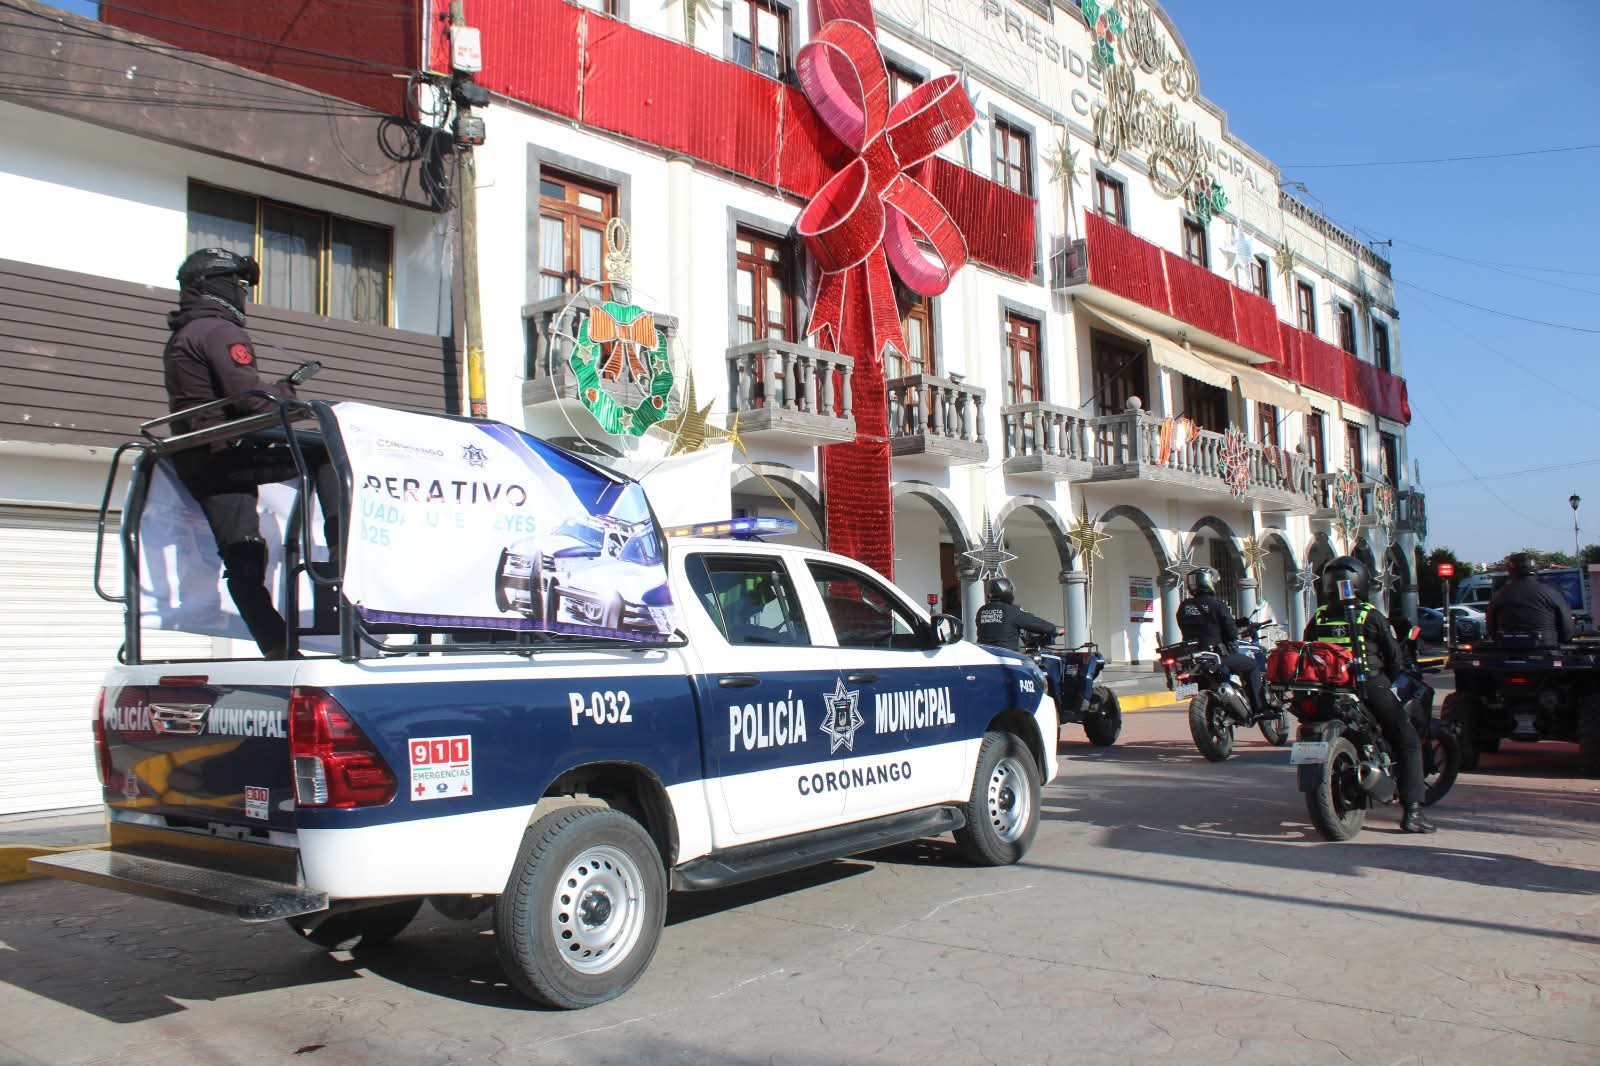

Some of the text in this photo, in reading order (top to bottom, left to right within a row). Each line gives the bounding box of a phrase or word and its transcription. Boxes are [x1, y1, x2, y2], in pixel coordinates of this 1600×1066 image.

[983, 0, 1265, 194] PRESIDE NICIPAL
[362, 475, 527, 507] PERATIVO
[208, 707, 288, 739] MUNICIPAL
[569, 690, 632, 726] P-032
[729, 686, 956, 752] POLICÍA MUNICIPAL
[415, 741, 464, 763] 911
[412, 768, 470, 781] EMERGENCIAS
[798, 760, 912, 796] CORONANGO
